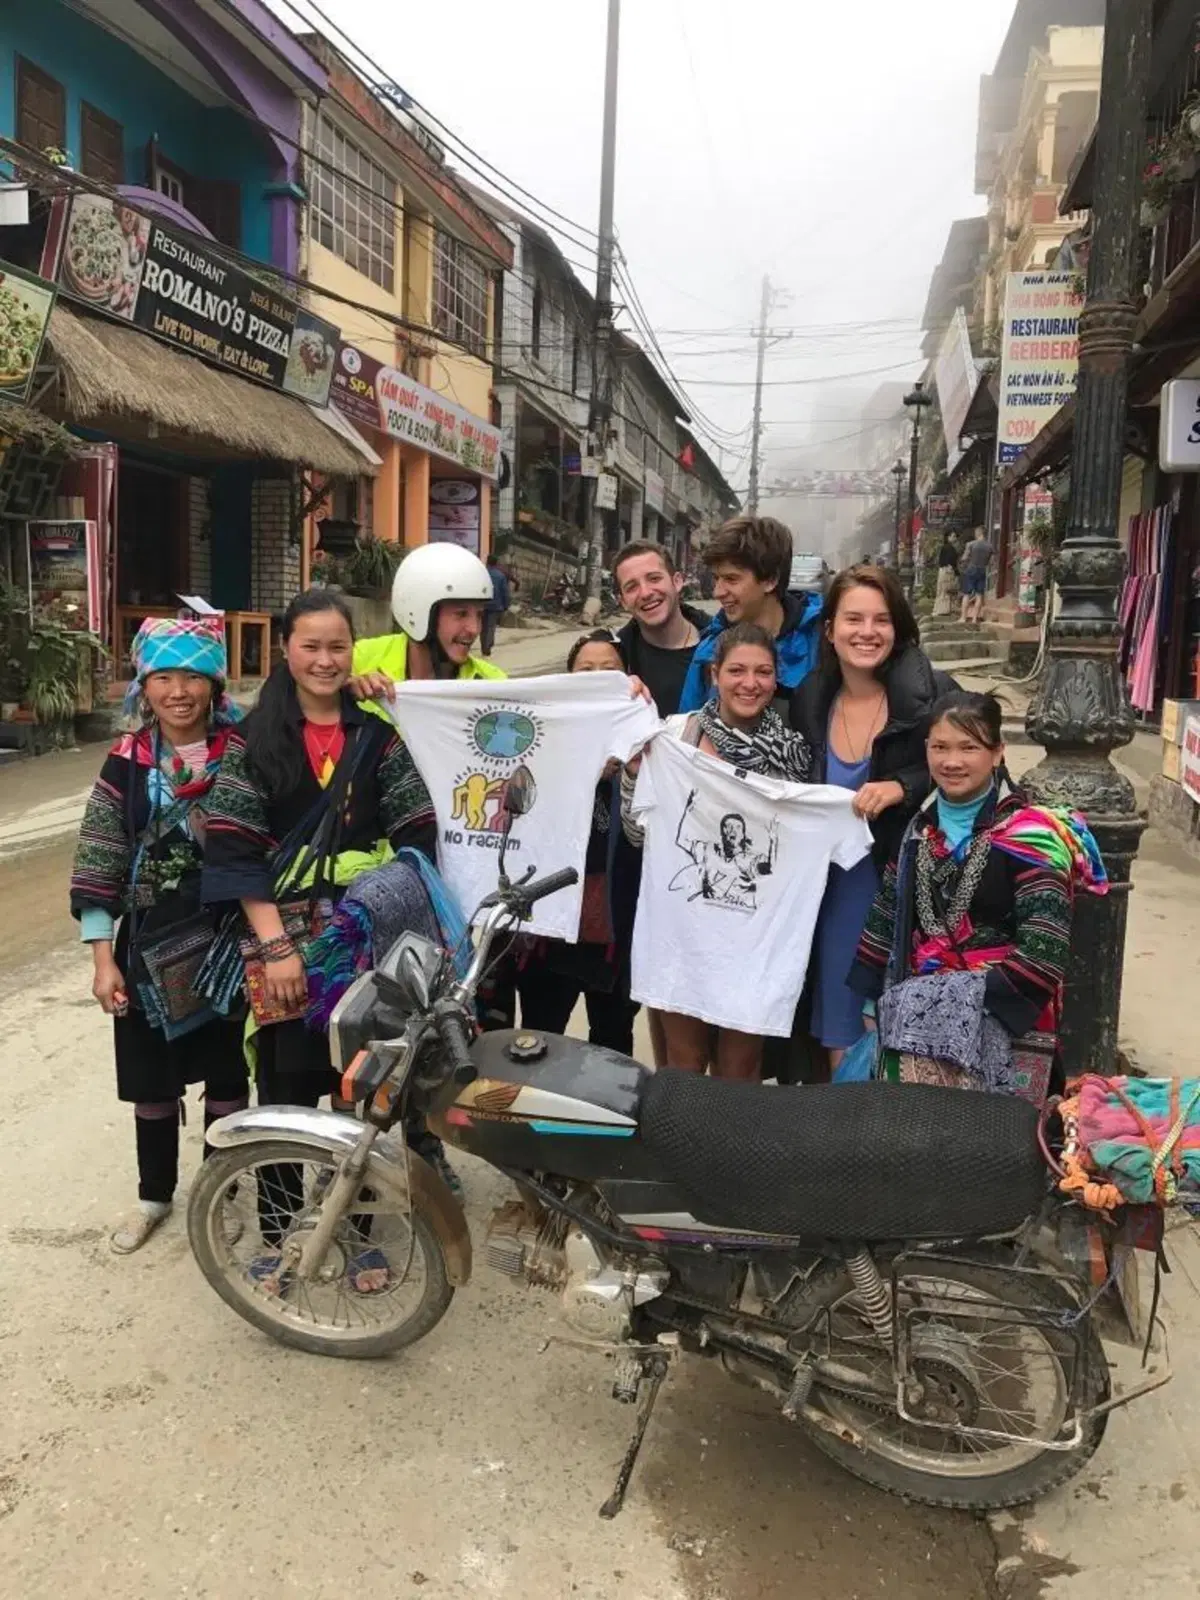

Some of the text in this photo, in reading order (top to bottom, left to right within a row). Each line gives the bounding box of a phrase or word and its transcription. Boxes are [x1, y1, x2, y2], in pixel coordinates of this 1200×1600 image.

[153, 229, 227, 285] RESTAURANT
[142, 258, 290, 358] ROMANO'S PIZZA
[154, 309, 179, 338] LIVE
[179, 322, 192, 342] TO
[223, 344, 240, 365] EAT
[349, 375, 374, 401] SPA
[388, 408, 407, 431] FOOT
[407, 418, 414, 435] &
[444, 829, 463, 844] NO
